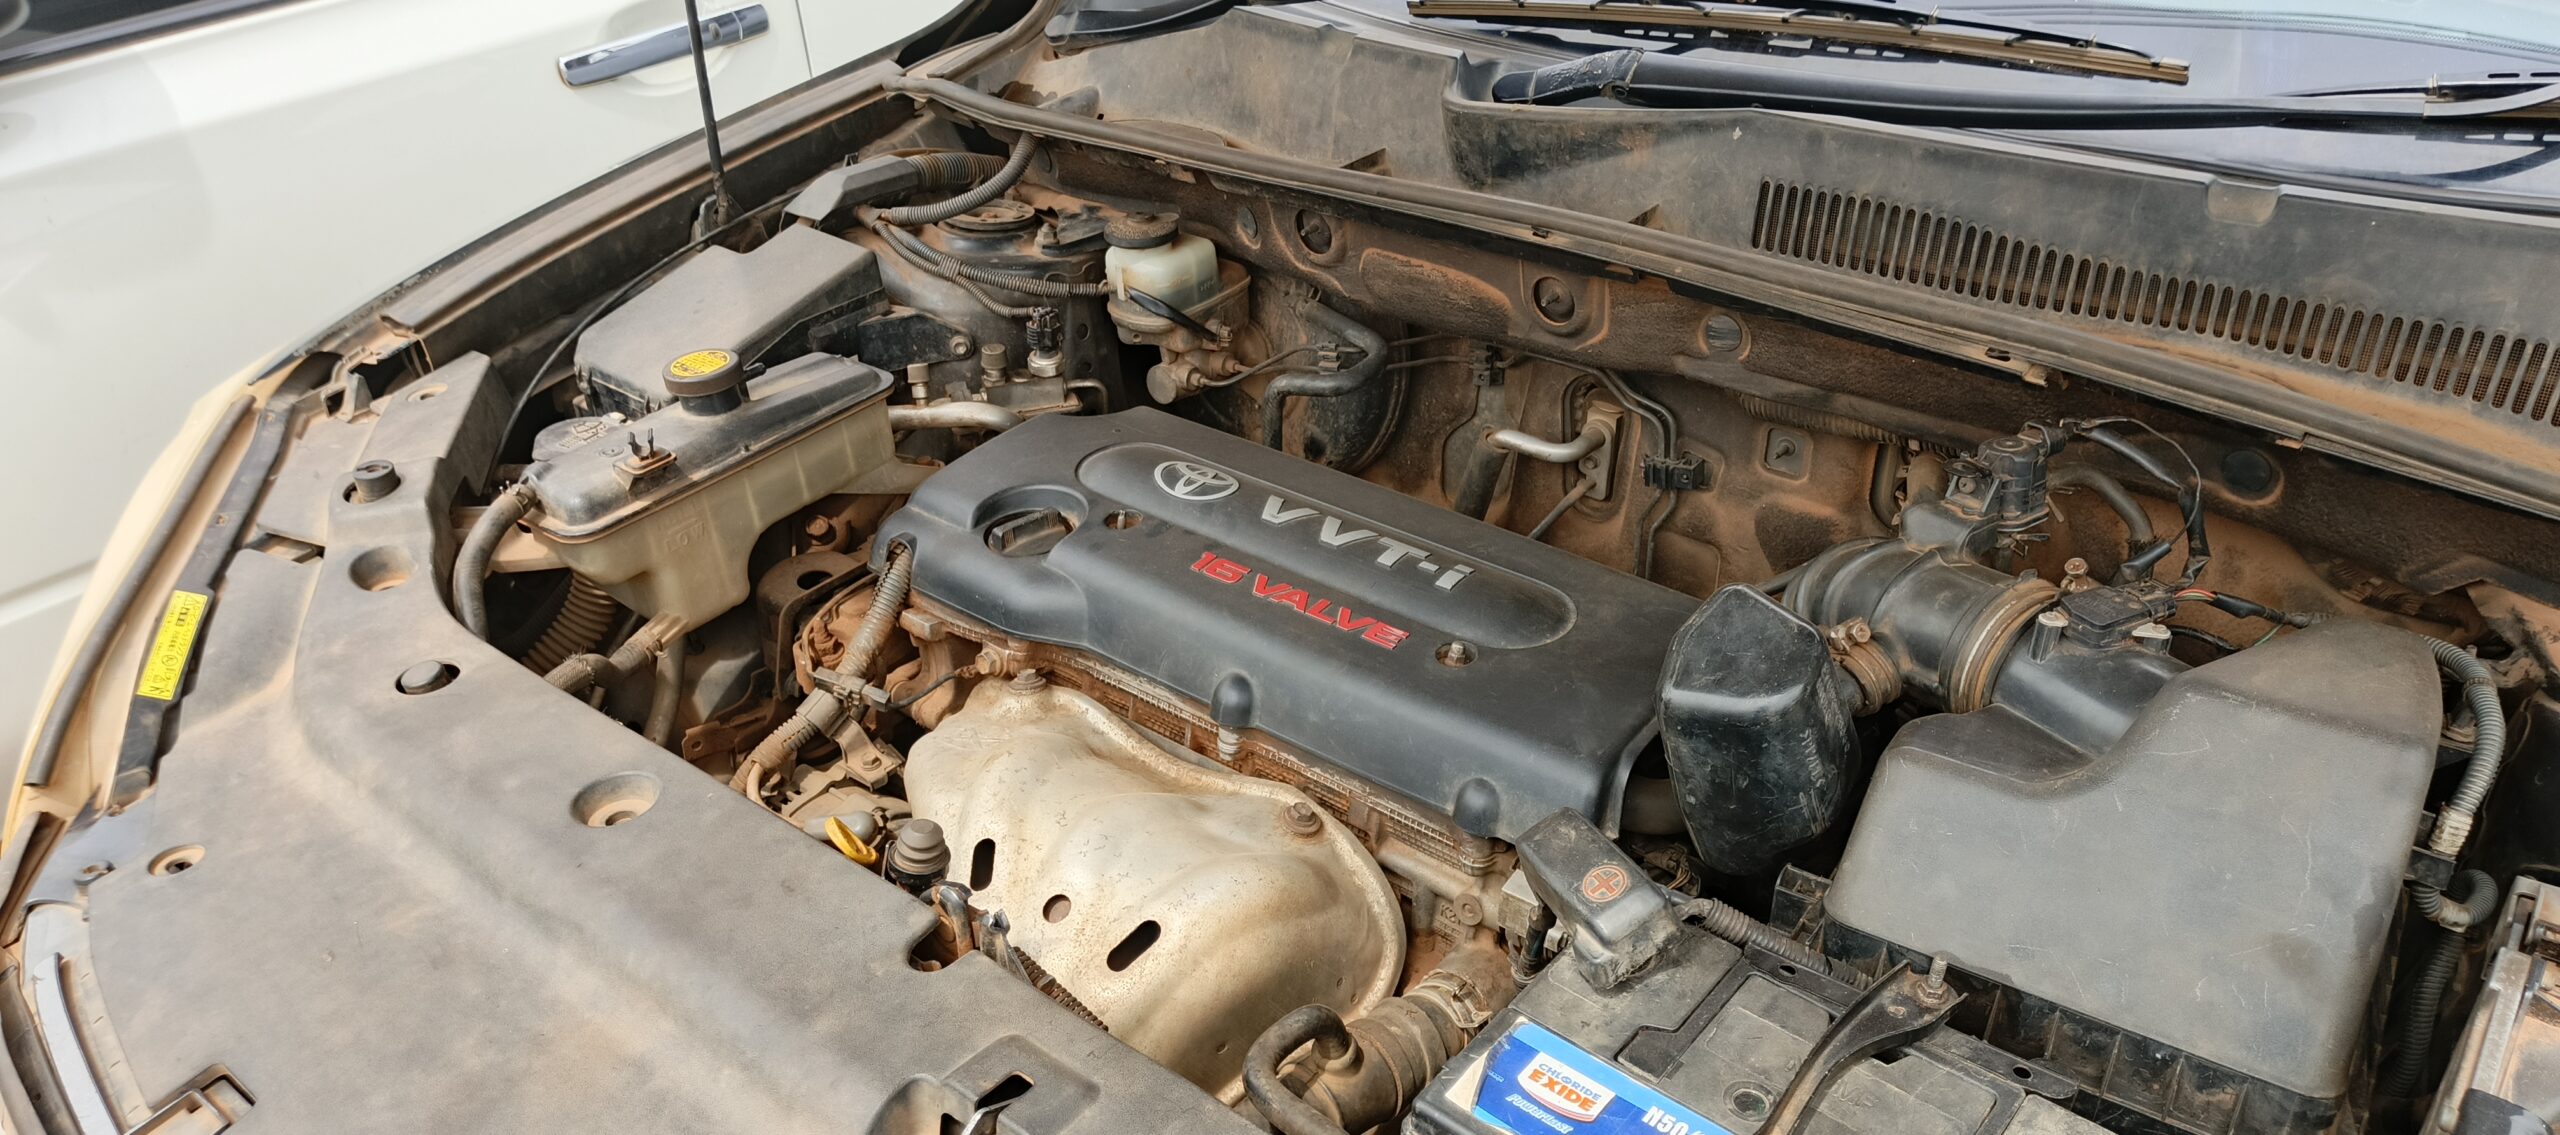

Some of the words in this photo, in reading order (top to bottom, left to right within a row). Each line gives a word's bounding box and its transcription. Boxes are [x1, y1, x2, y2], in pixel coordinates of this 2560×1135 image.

[1261, 494, 1476, 592] VVT-i
[1191, 551, 1252, 584] 16
[1253, 573, 1410, 650] VALVE
[1528, 1068, 1598, 1112] EXIDE
[1538, 1063, 1602, 1101] CHLORIDE
